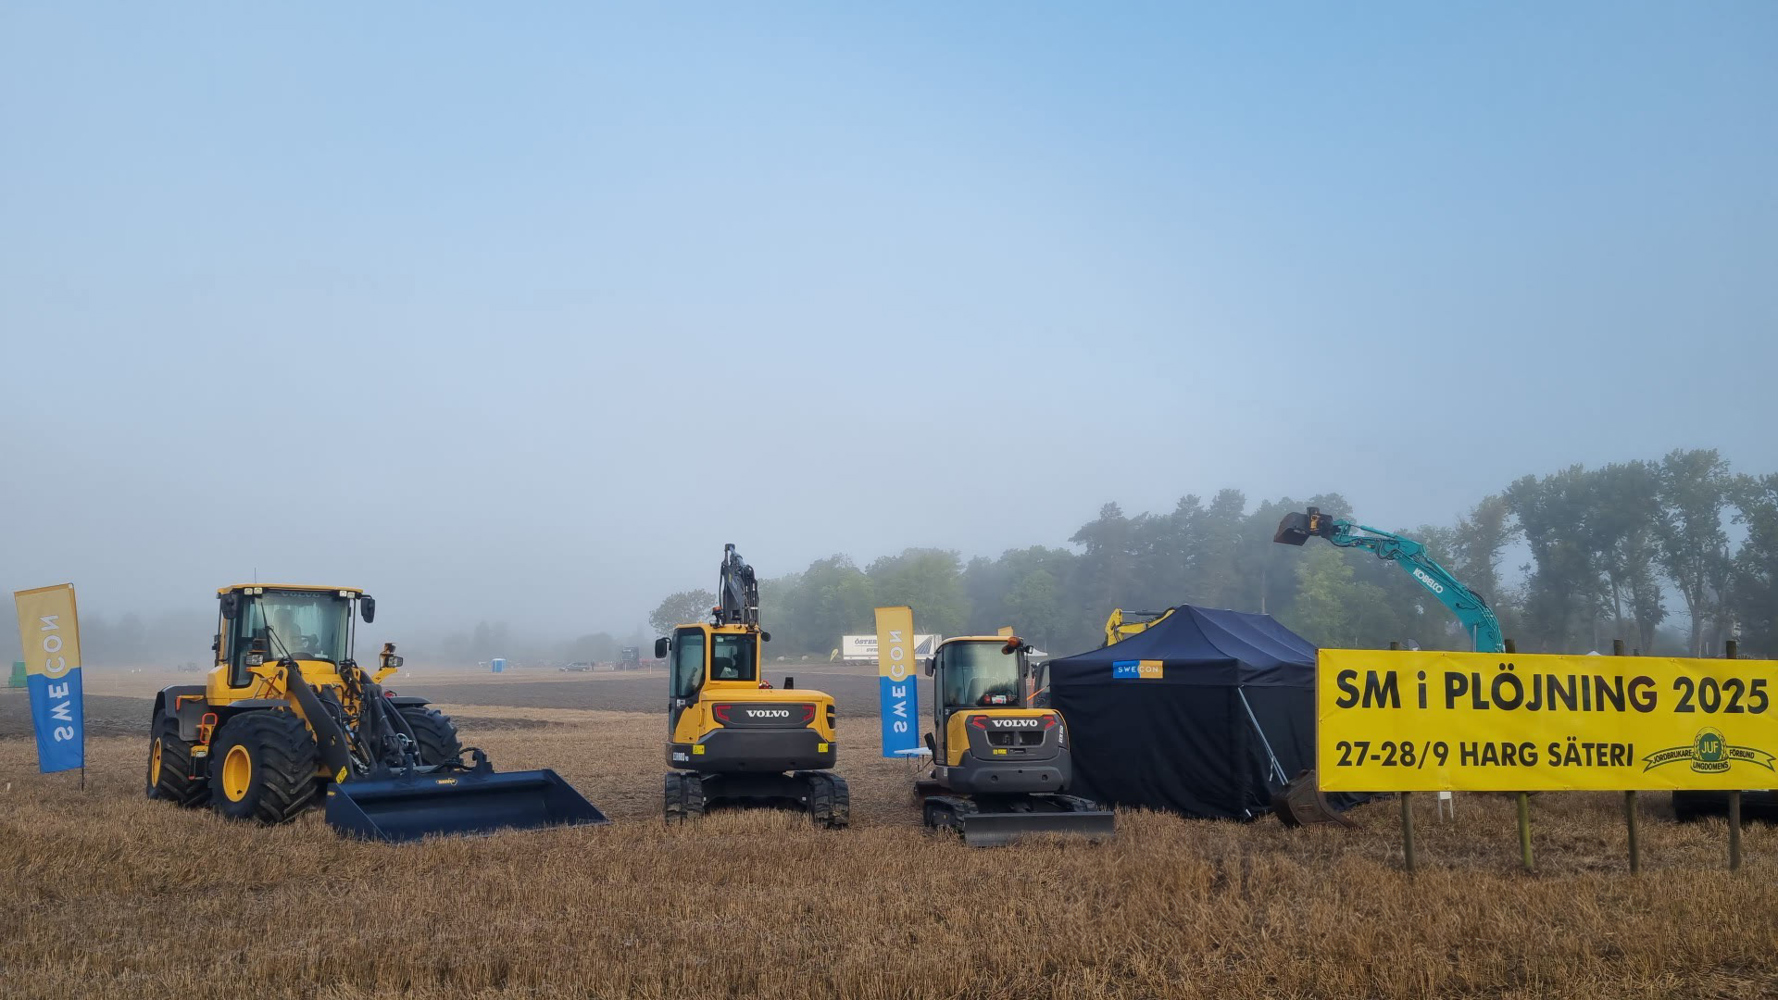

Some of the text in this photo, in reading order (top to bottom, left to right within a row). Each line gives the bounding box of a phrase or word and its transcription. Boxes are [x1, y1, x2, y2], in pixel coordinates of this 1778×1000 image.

[1412, 567, 1444, 594] KOBELCO
[1117, 665, 1160, 675] SWECON
[1336, 662, 1769, 715] SM i PLÖJNING 2025
[746, 709, 790, 718] VOLVO
[991, 719, 1038, 728] VOLVO
[1336, 736, 1634, 770] 27-28/9 HARG SÄTERI
[1702, 741, 1719, 754] JUF
[1693, 761, 1729, 771] UNGDOMENS
[1729, 749, 1755, 760] FÖRBUND
